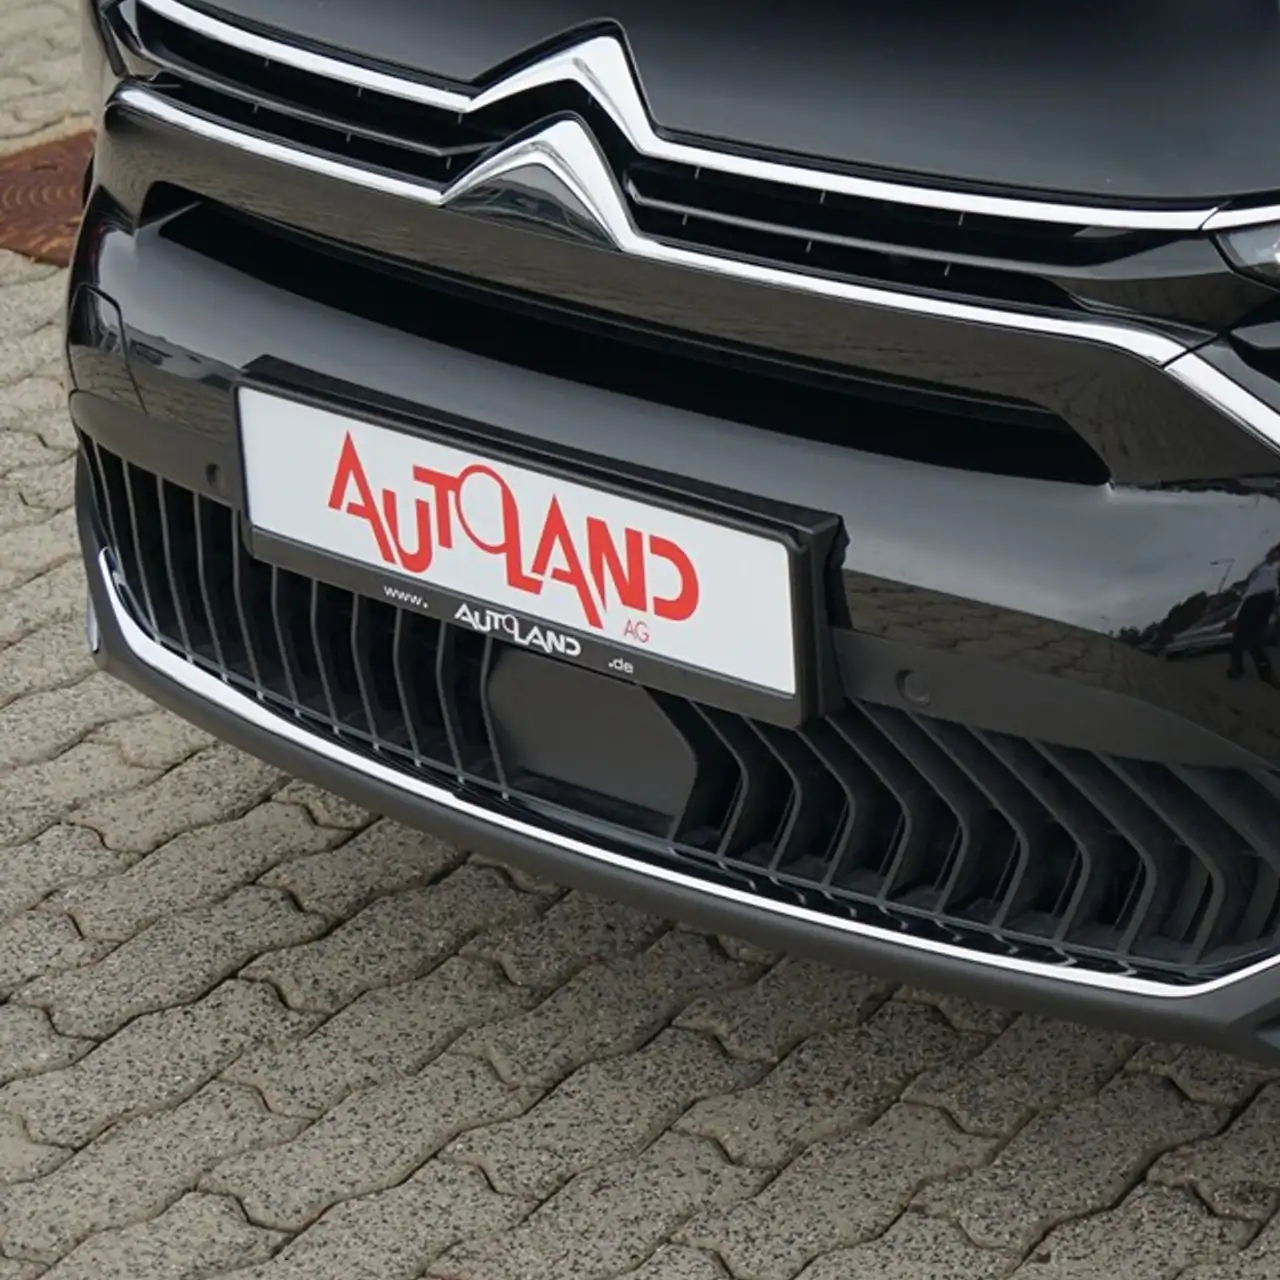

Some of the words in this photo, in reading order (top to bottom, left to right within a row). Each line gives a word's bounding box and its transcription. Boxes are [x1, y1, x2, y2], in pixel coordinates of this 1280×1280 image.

[327, 431, 702, 631] AUTOLAND
[453, 603, 582, 657] AUTOLAND
[607, 657, 634, 674] .de
[624, 617, 651, 644] AG
